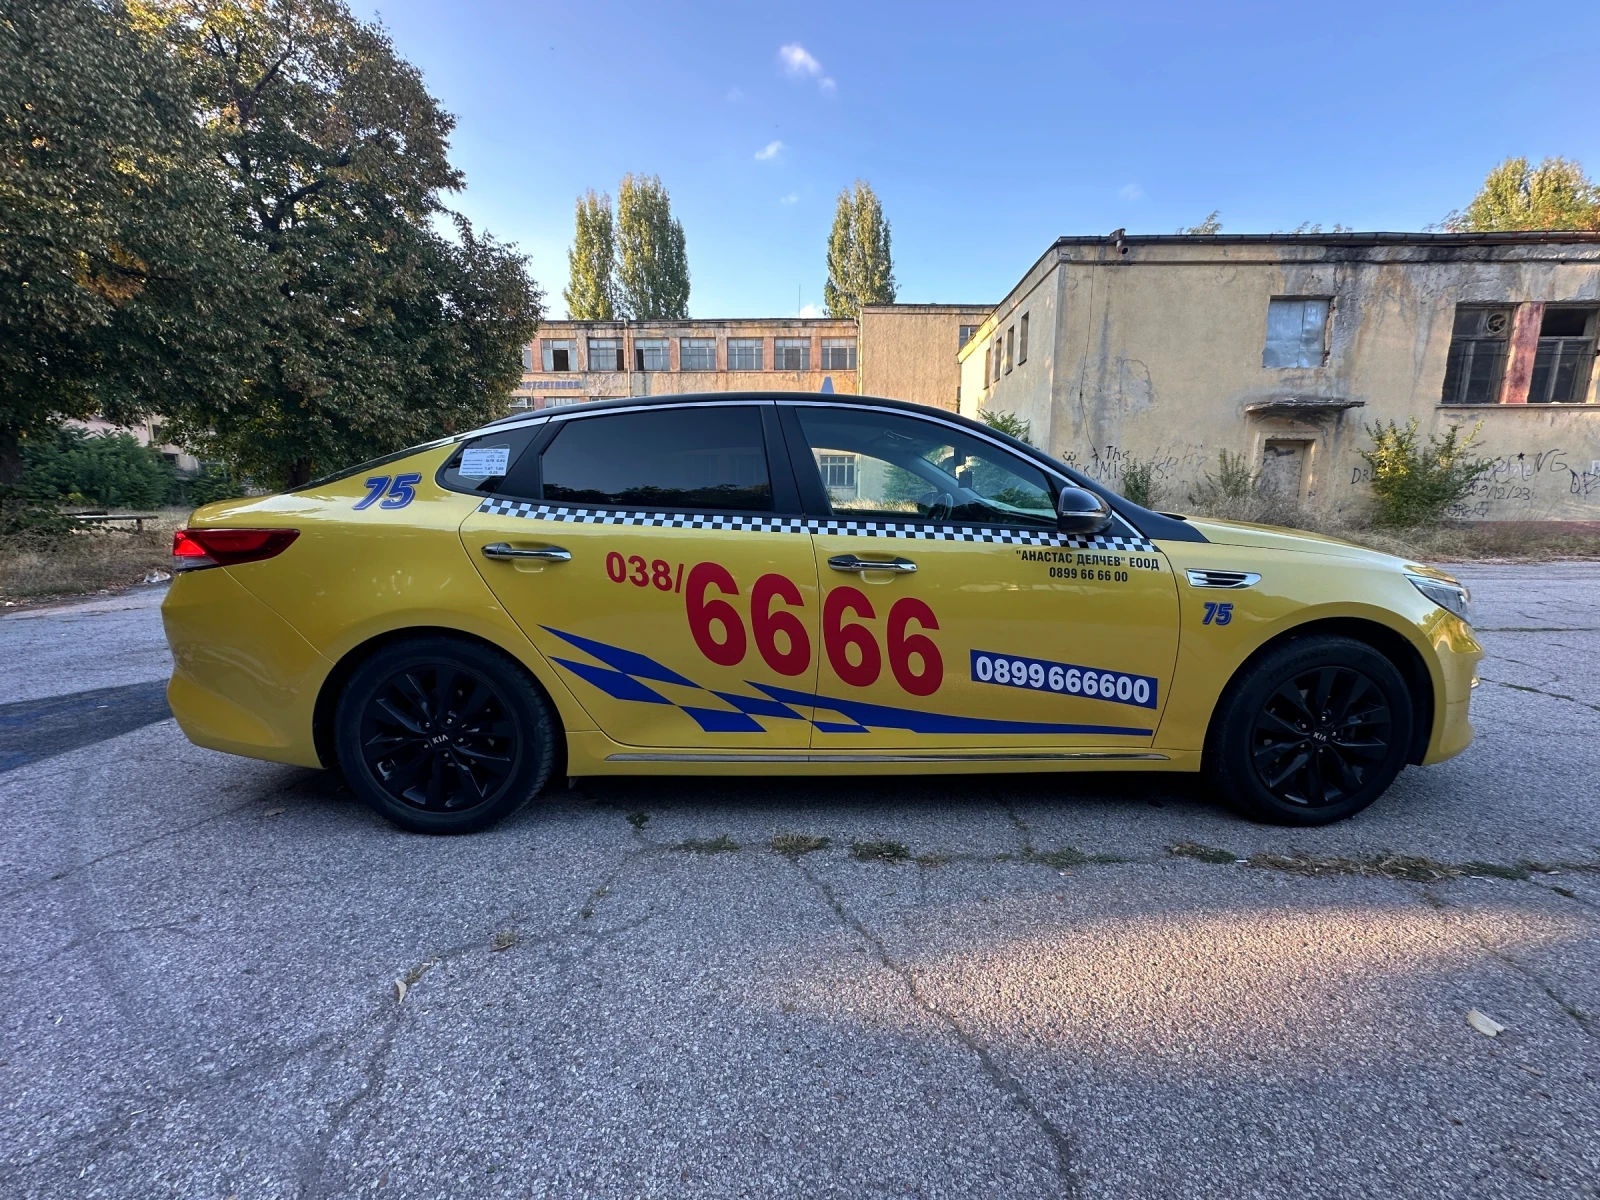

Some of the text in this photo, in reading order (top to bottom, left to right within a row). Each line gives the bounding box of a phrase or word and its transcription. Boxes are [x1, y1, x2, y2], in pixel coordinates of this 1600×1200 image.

[351, 472, 422, 510] 75
[1016, 549, 1160, 571] "АНАСТАС ДЕЛЧЕВ" ЕООД
[1049, 566, 1128, 582] 0899 66 66 00
[1201, 601, 1234, 626] 75
[432, 734, 449, 744] KIA
[1312, 731, 1327, 742] KIA
